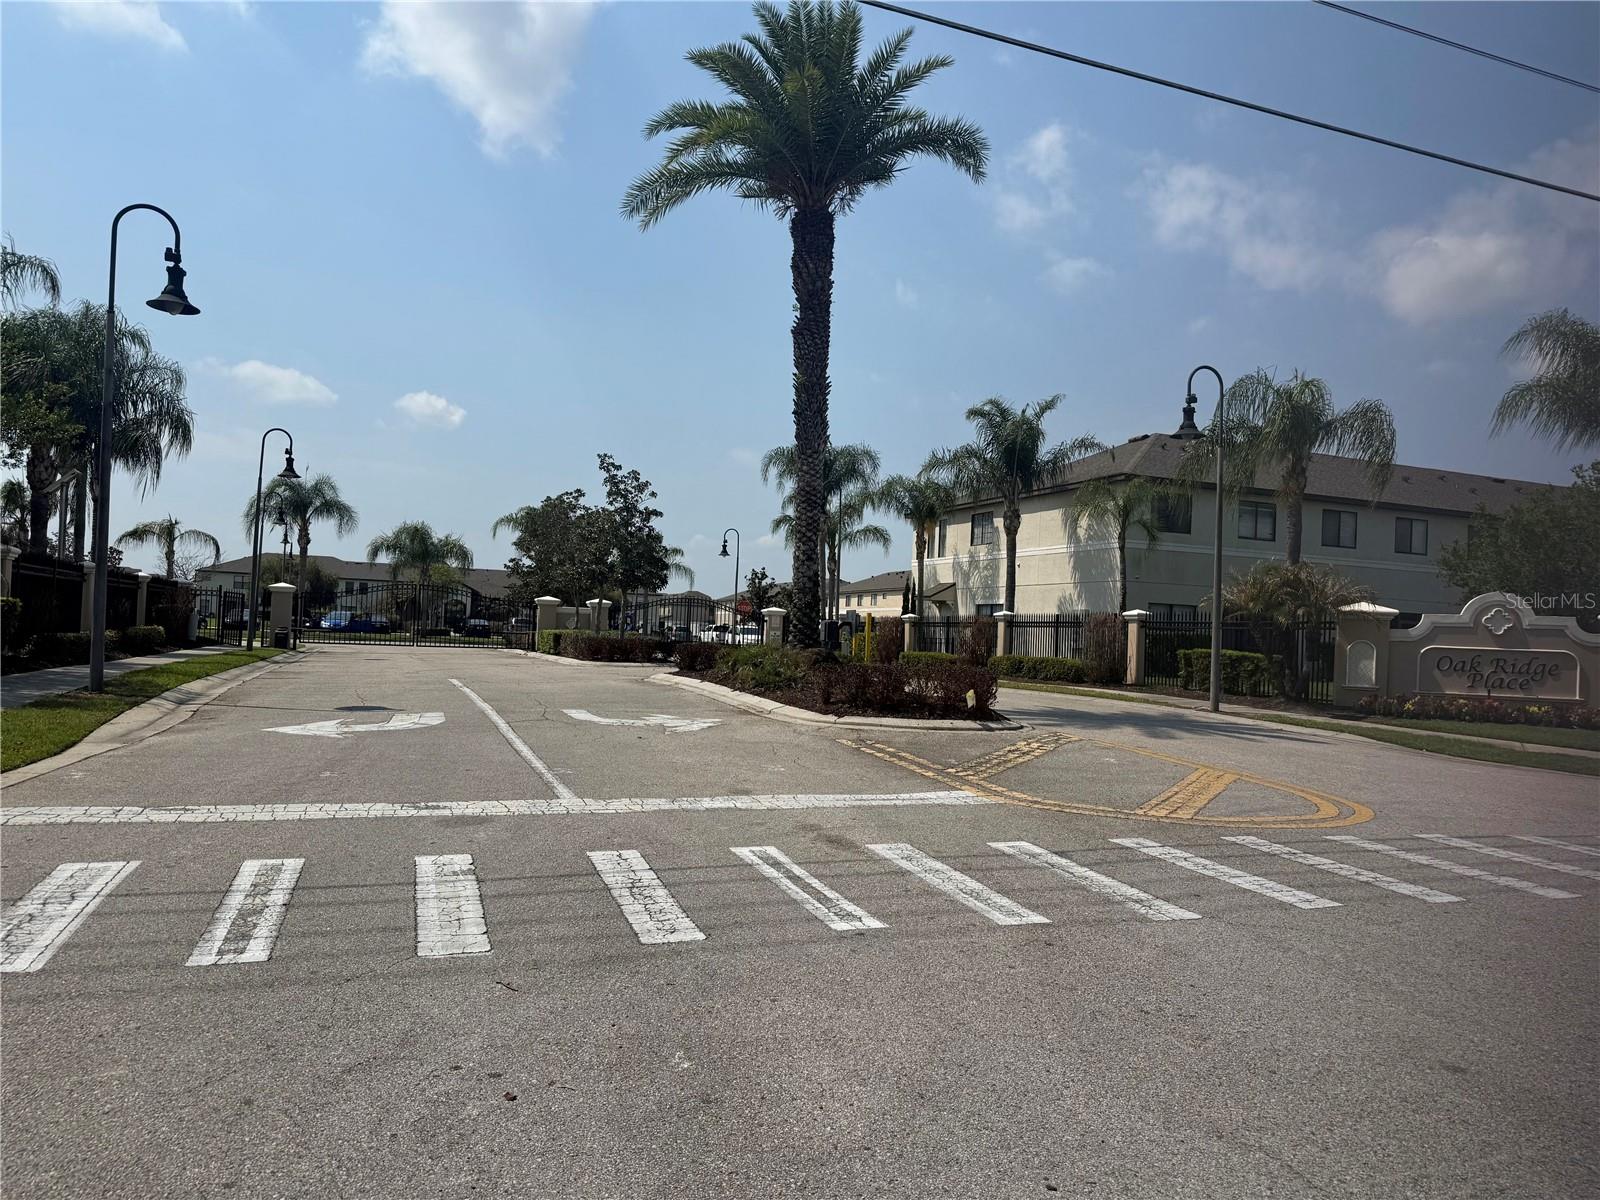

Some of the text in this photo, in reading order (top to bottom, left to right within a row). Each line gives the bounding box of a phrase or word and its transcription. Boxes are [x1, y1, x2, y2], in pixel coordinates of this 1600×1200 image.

[1436, 654, 1560, 681] Oak Ridge
[1466, 670, 1530, 690] Place
